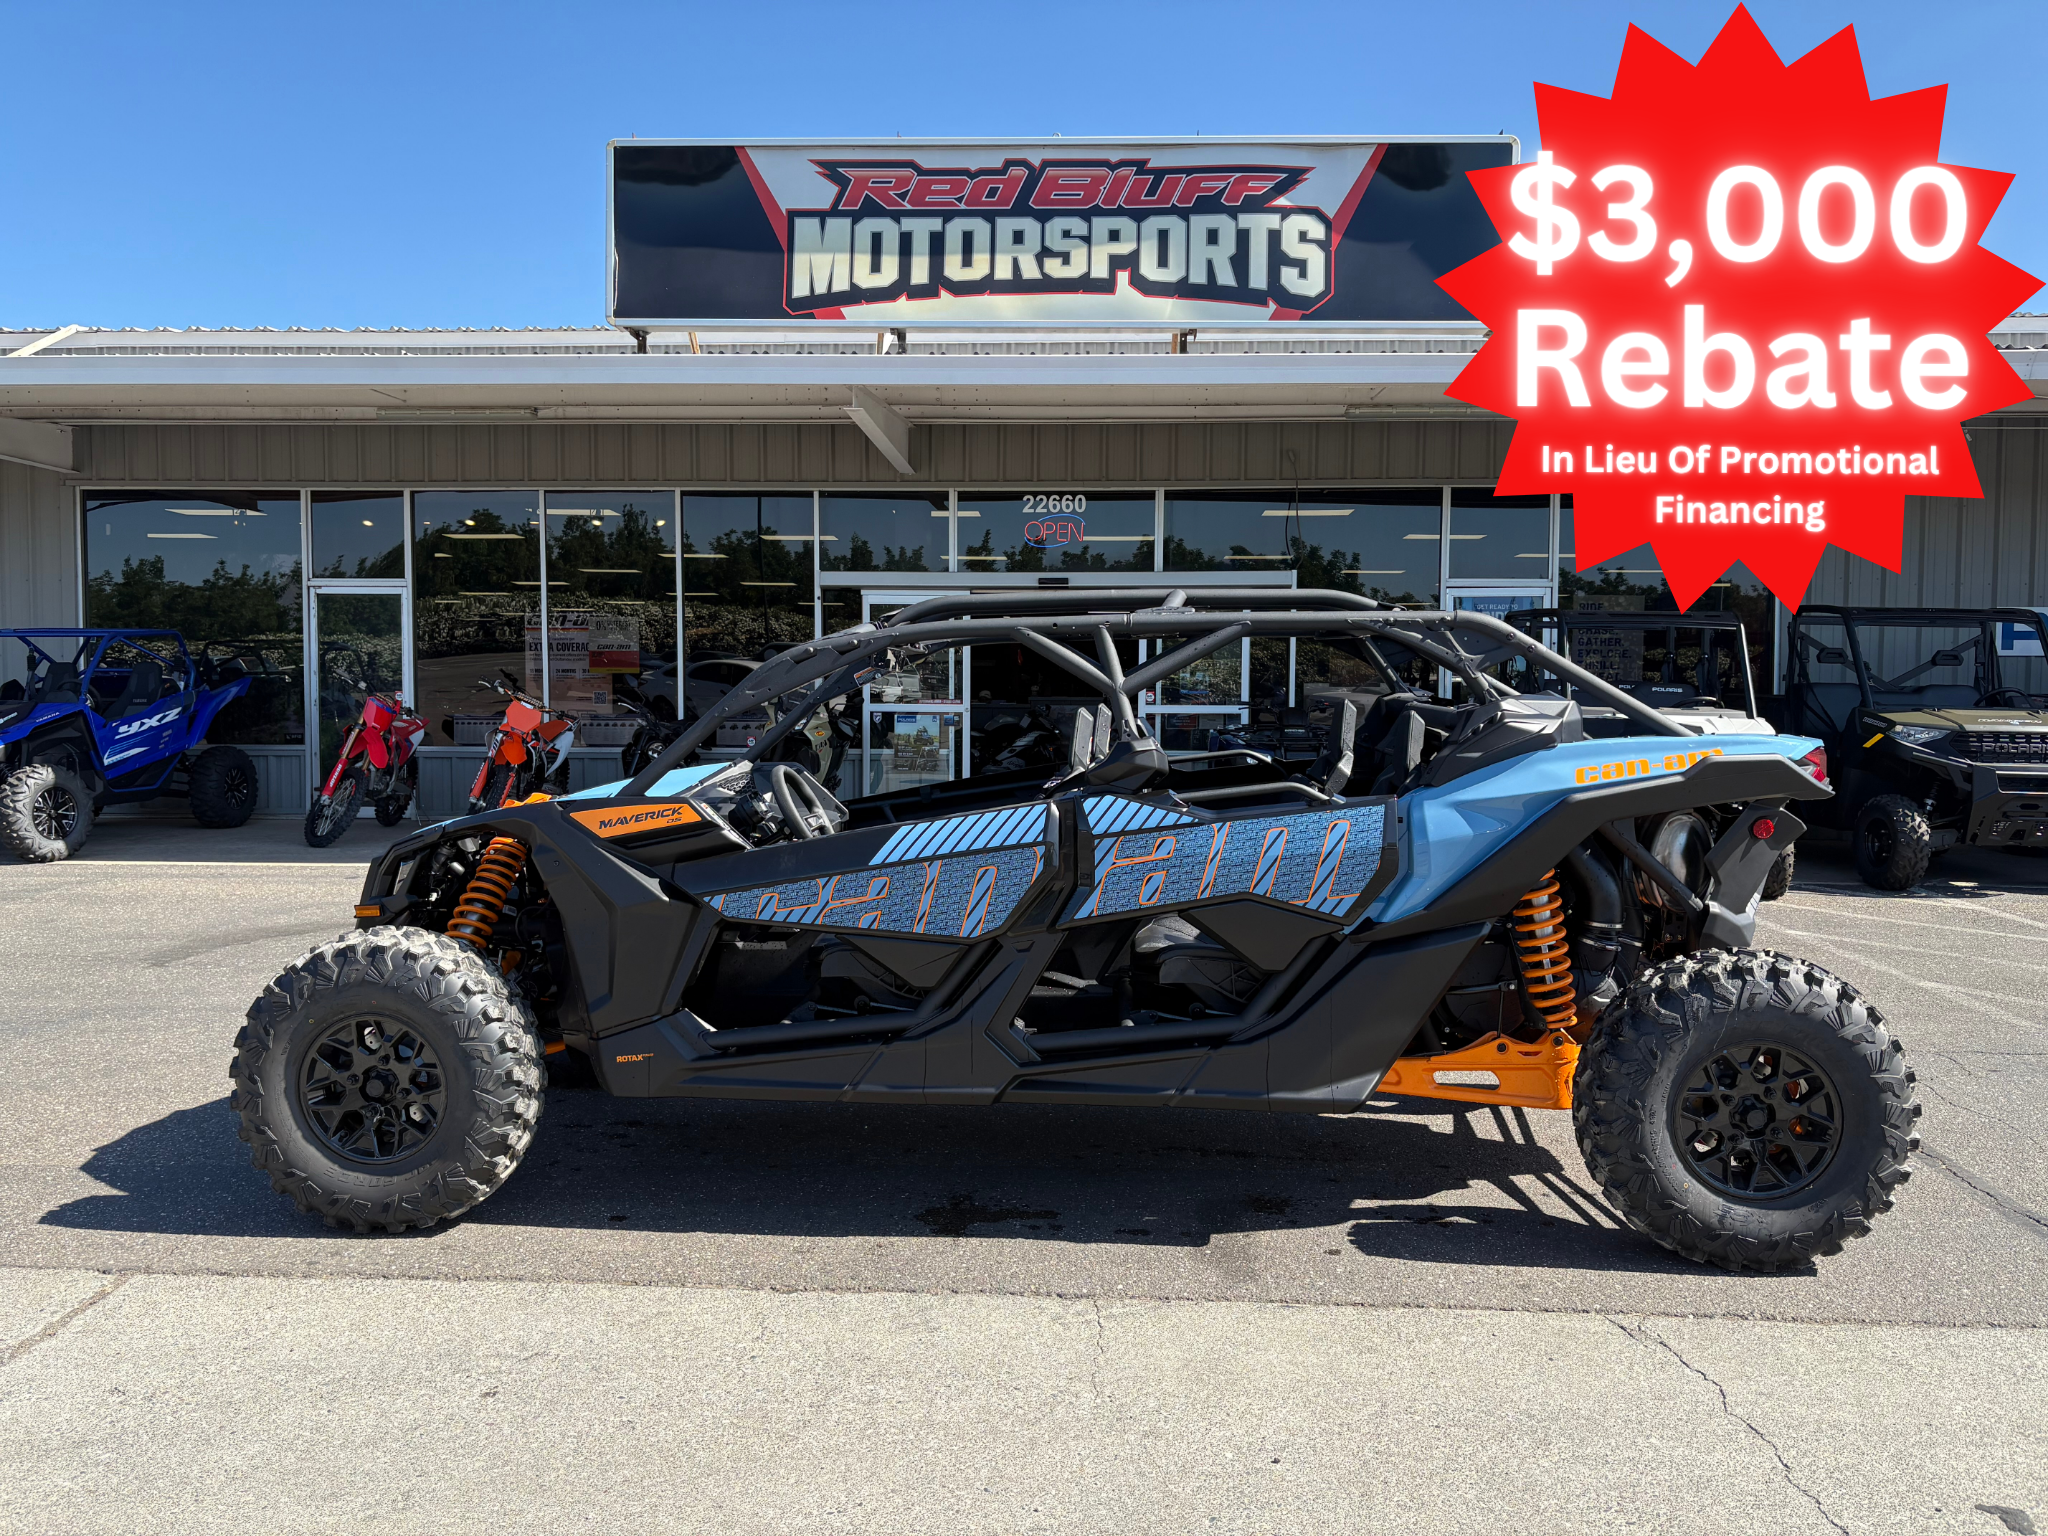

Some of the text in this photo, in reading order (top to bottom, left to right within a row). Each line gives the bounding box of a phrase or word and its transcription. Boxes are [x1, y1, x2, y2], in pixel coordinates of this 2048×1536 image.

[838, 167, 1029, 209] Red
[791, 212, 1327, 299] MOTORSPORTS
[1022, 494, 1087, 513] 22660
[1024, 520, 1084, 542] OPEN
[1577, 637, 1625, 647] GATHER.
[1577, 648, 1632, 659] EXPLORE.
[598, 805, 685, 830] MAVERICK
[666, 816, 683, 824] DS
[616, 1054, 644, 1063] ROTAX
